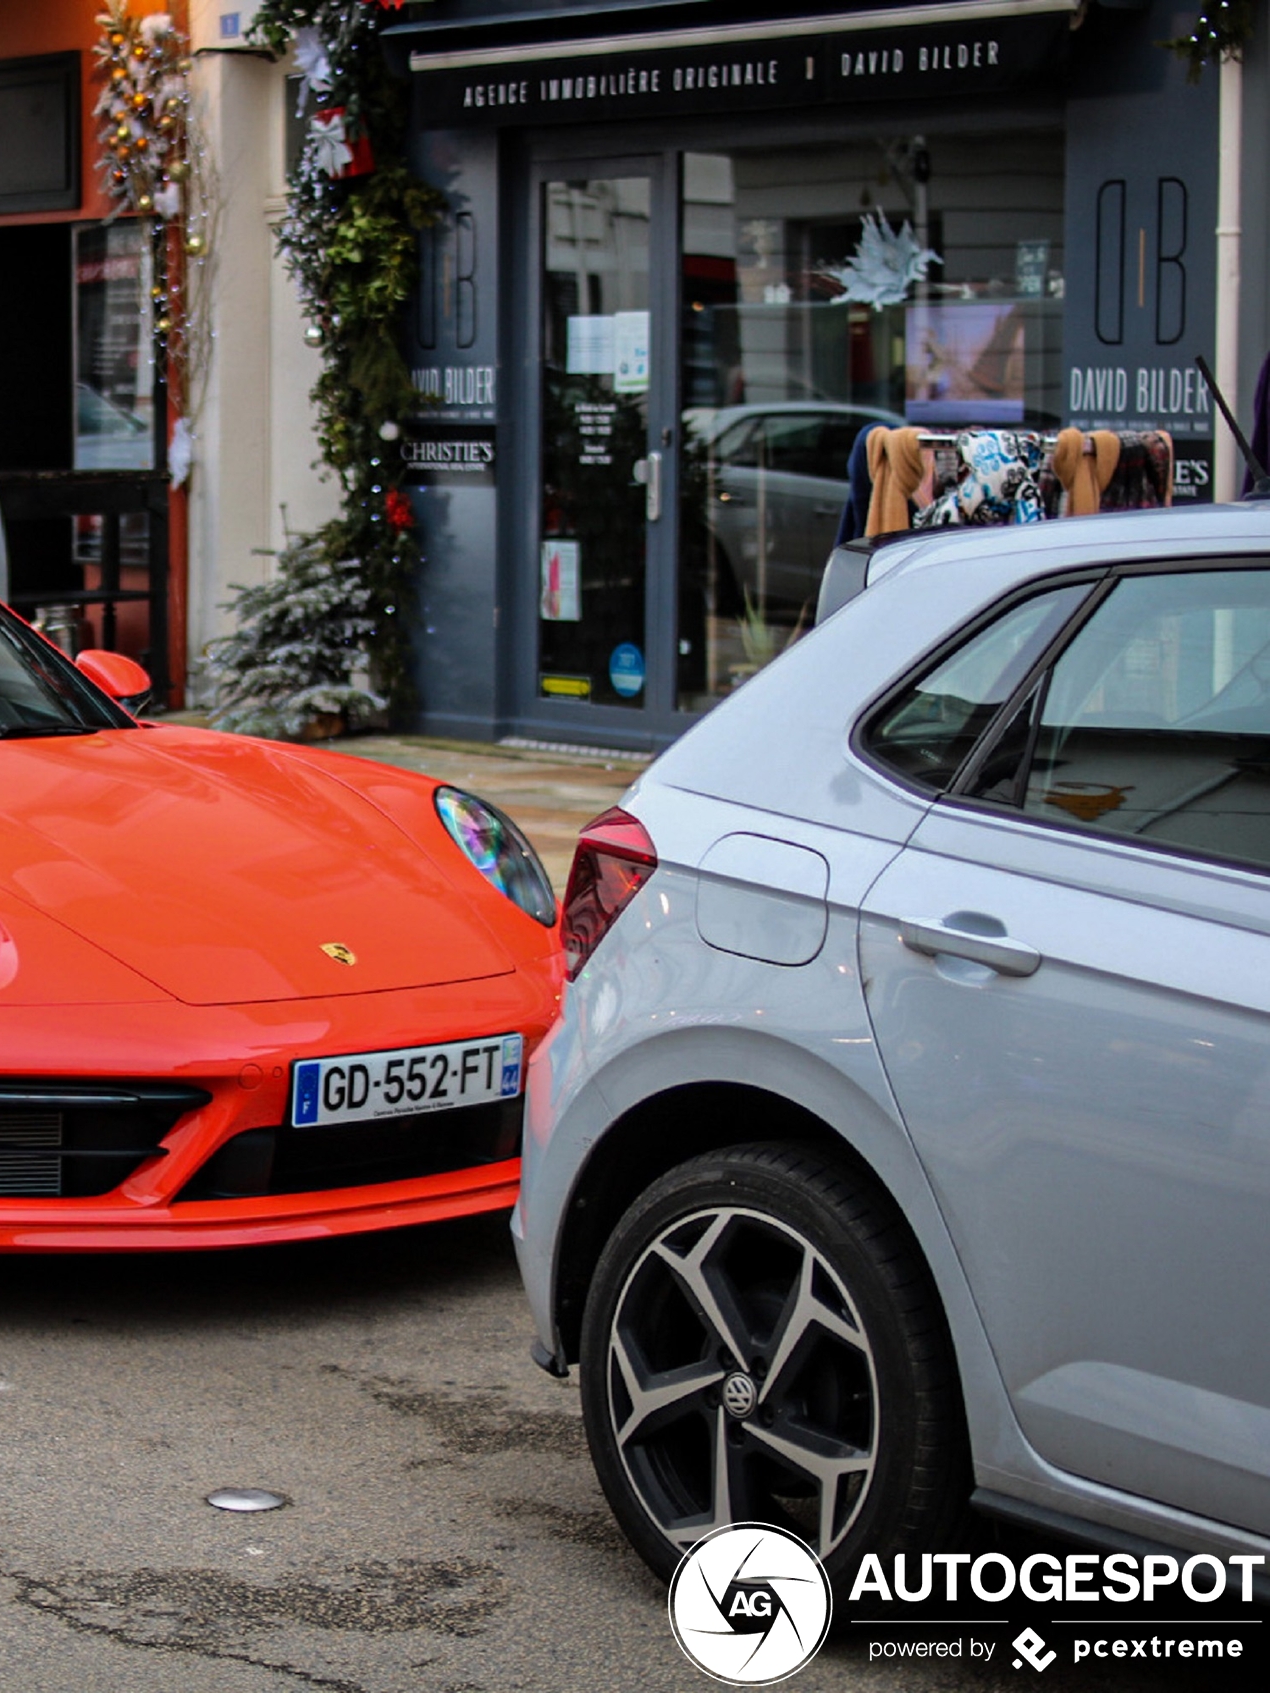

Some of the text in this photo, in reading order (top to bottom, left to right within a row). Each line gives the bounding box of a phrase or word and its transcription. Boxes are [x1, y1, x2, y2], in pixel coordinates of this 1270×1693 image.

[463, 40, 999, 107] AGENCE IMMOBILIÈRE ORIGINALE DAVID BILDER
[444, 367, 495, 404] BILDER
[1070, 366, 1209, 414] DAVID BILDER
[400, 441, 495, 463] CHRISTIE'S
[302, 1044, 500, 1115] F GD-552-FT
